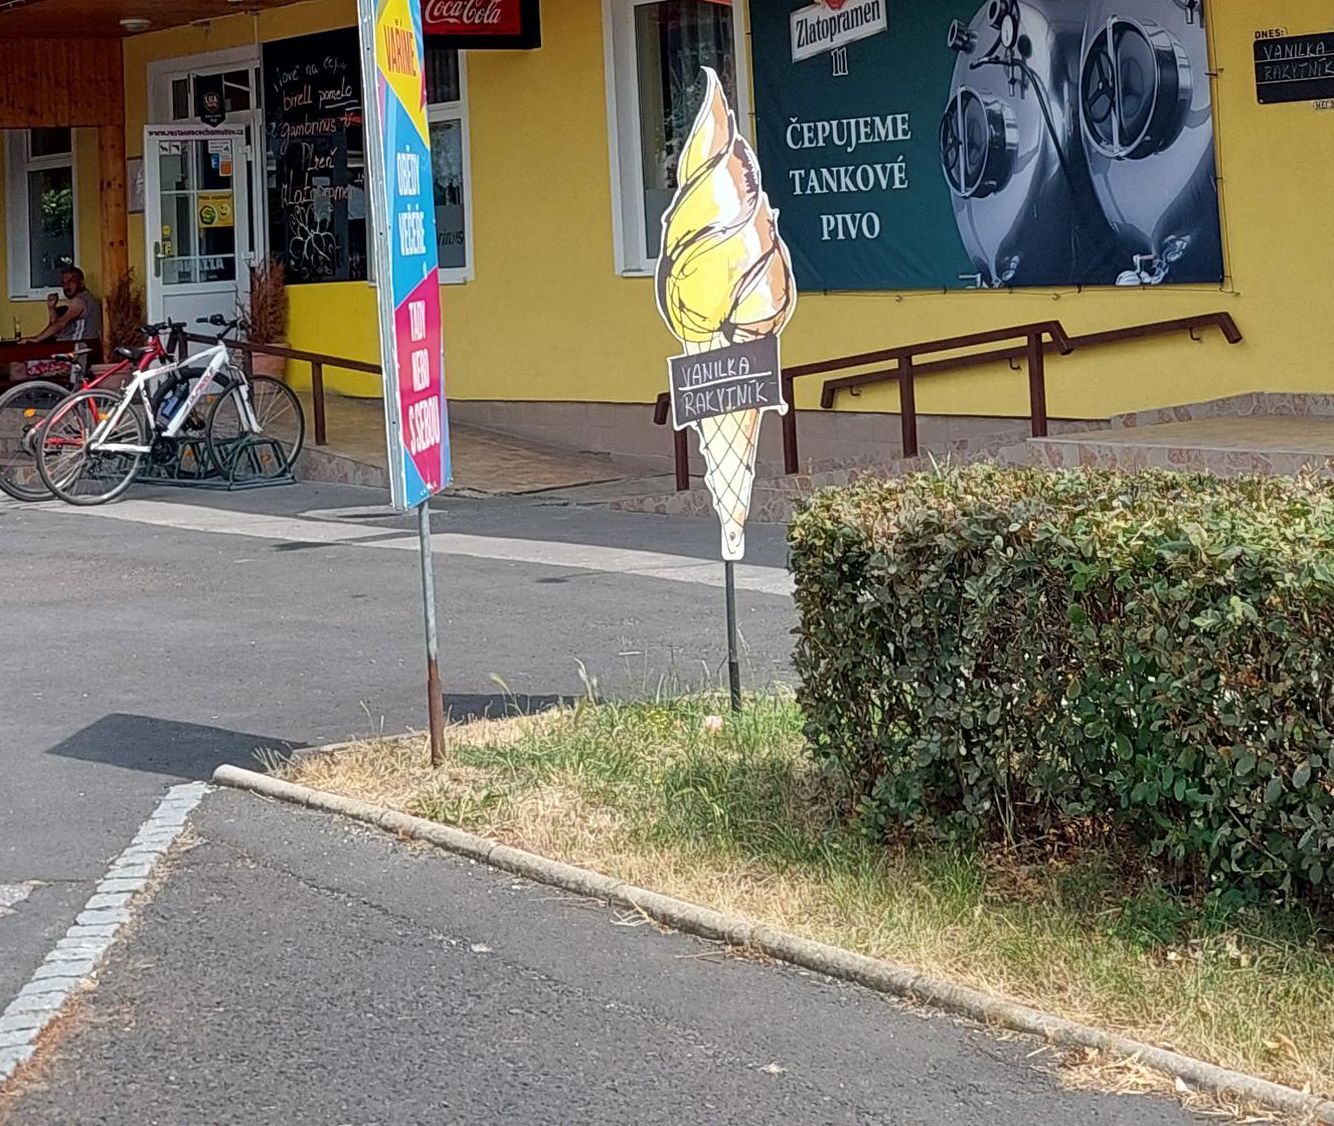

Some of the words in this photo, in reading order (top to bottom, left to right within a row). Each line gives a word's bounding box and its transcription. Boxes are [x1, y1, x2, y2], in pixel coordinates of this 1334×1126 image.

[1254, 28, 1285, 40] DNES:
[830, 47, 849, 77] 11
[1263, 41, 1326, 61] VANILKA
[785, 112, 913, 154] ČEPUJEME
[789, 154, 909, 195] TANKOVÉ
[820, 211, 881, 241] PIVO
[682, 356, 750, 387] VANILKA
[682, 379, 769, 417] RAKYTNÍK
